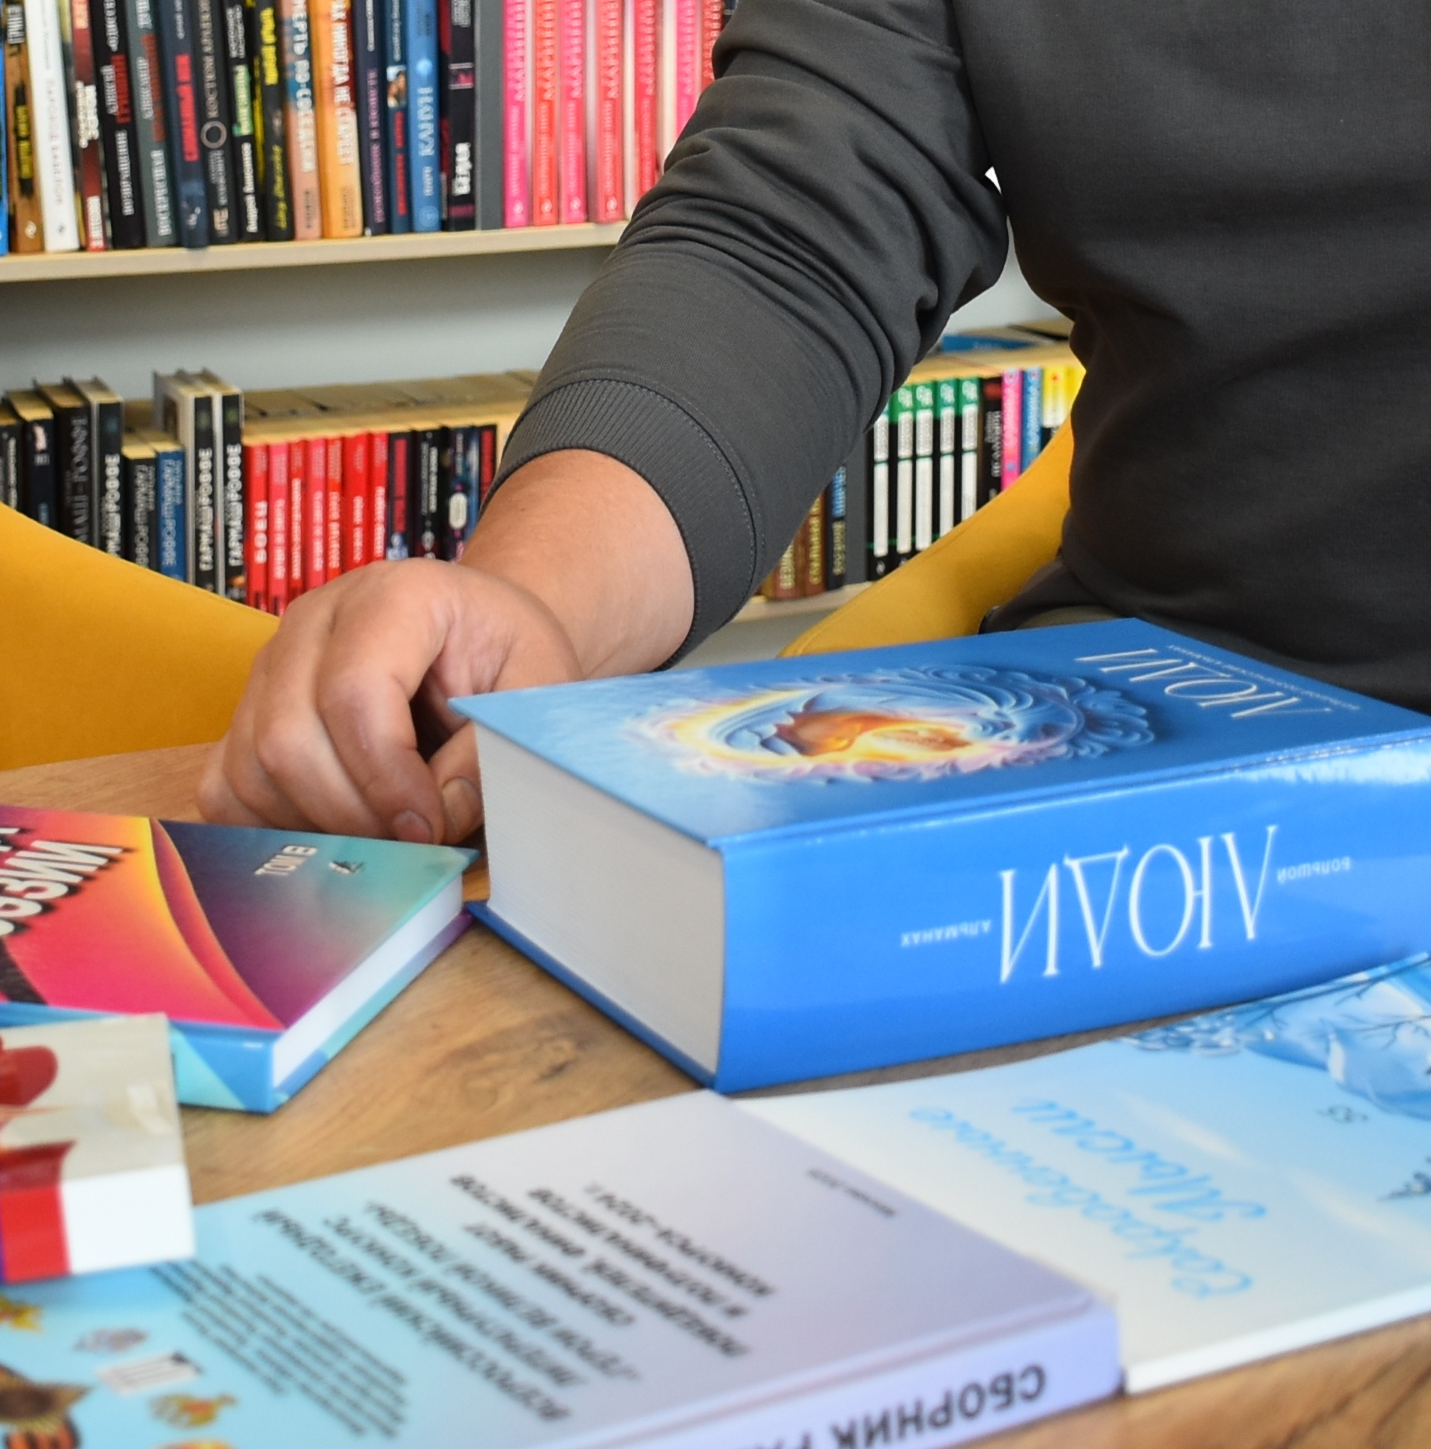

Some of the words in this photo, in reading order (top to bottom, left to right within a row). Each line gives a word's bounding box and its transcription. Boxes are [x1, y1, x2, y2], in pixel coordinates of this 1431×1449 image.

[331, 23, 350, 83] НИКОГДА
[295, 59, 316, 172] ПО-СОСЕДСКИ
[334, 86, 351, 106] НЕ
[416, 87, 434, 157] КАНУН
[335, 109, 353, 166] СТАРЕЕТ
[1074, 648, 1332, 719] ЛЮДИ
[254, 849, 298, 877] ТОМ
[1277, 856, 1351, 883] БОЛЬШОЙ
[901, 919, 991, 946] АЛЬМАНАХ
[999, 824, 1278, 984] ЛЮДИ
[324, 1214, 418, 1283] КОНКУРС
[450, 1173, 586, 1258] ФИНАЛИСТОВ
[464, 1221, 534, 1264] РАБОТ
[528, 1186, 734, 1307] ПОЛУФИНАЛИСТОВ
[253, 1209, 386, 1296] ЕЖЕГОДНЫЙ
[446, 1260, 559, 1330] ВЕЛИКОЙ
[530, 1261, 636, 1327] СБОРНИК
[370, 1292, 572, 1423] ВСЕРОССИЙСКИЙ
[831, 1365, 1046, 1449] СБОРНИК
